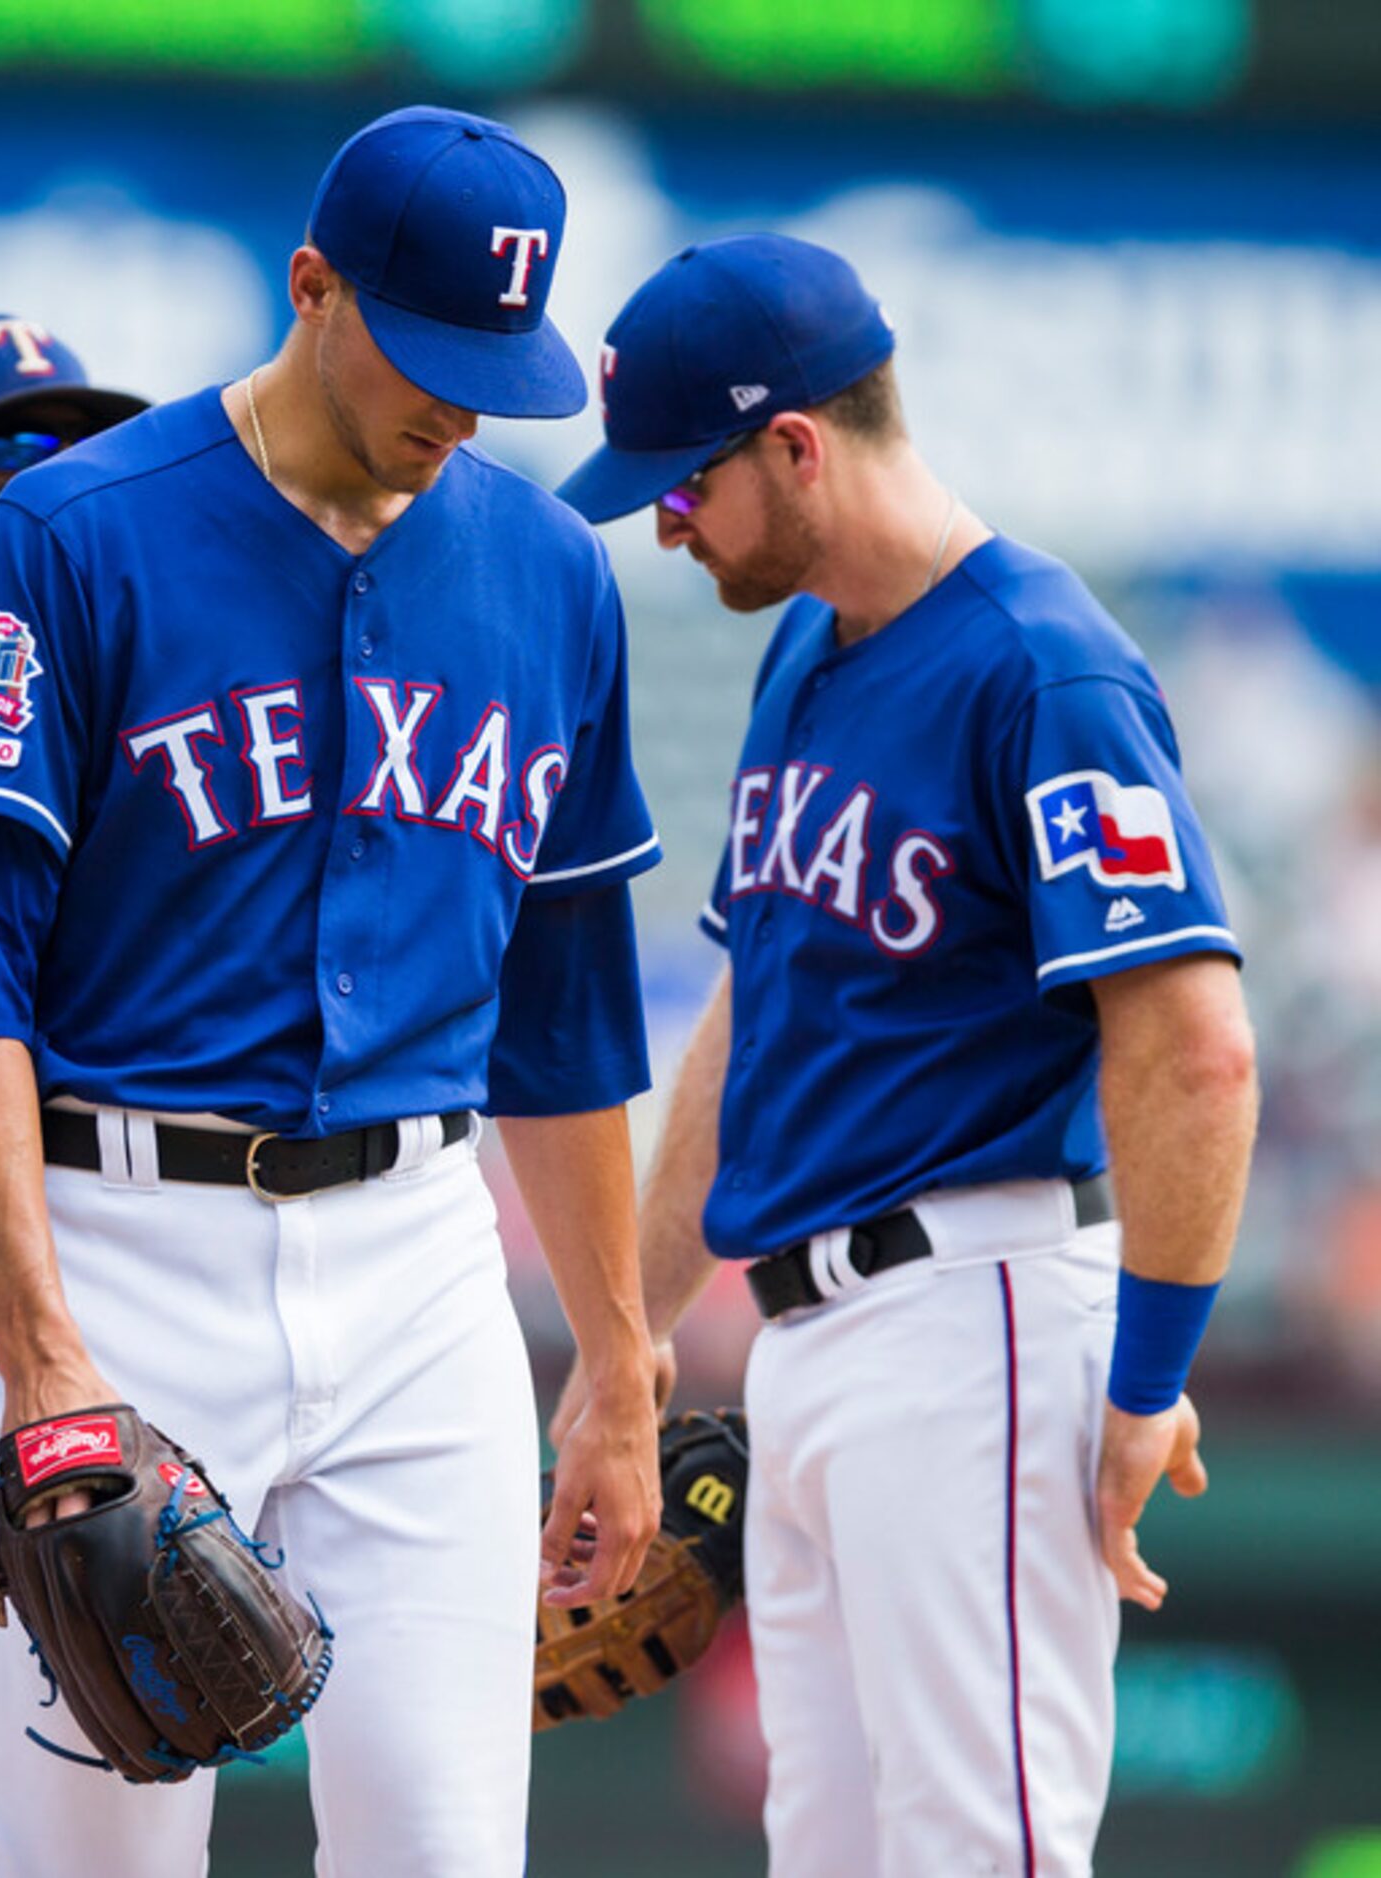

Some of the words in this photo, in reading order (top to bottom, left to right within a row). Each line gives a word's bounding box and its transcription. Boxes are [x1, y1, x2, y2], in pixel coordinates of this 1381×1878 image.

[491, 226, 548, 311] T
[119, 678, 568, 882] TEXAS
[729, 761, 955, 958] EXAS
